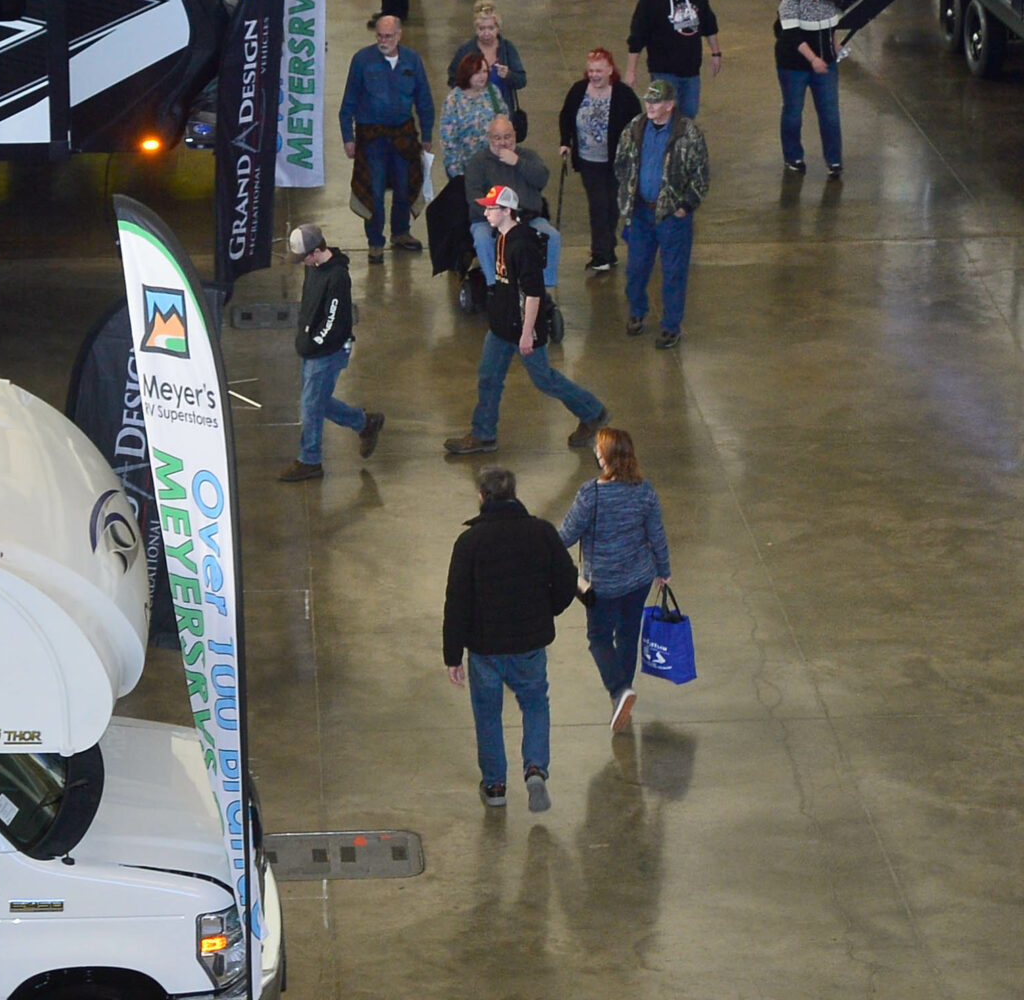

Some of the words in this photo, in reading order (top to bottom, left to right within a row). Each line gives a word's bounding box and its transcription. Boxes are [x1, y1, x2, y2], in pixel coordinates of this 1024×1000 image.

[238, 19, 259, 124] DESIGN
[229, 154, 252, 261] GRAND
[143, 373, 216, 409] Meyer's
[157, 405, 219, 429] Superstores
[3, 730, 42, 742] THOR
[192, 470, 227, 617] Over
[219, 749, 262, 940] Bra
